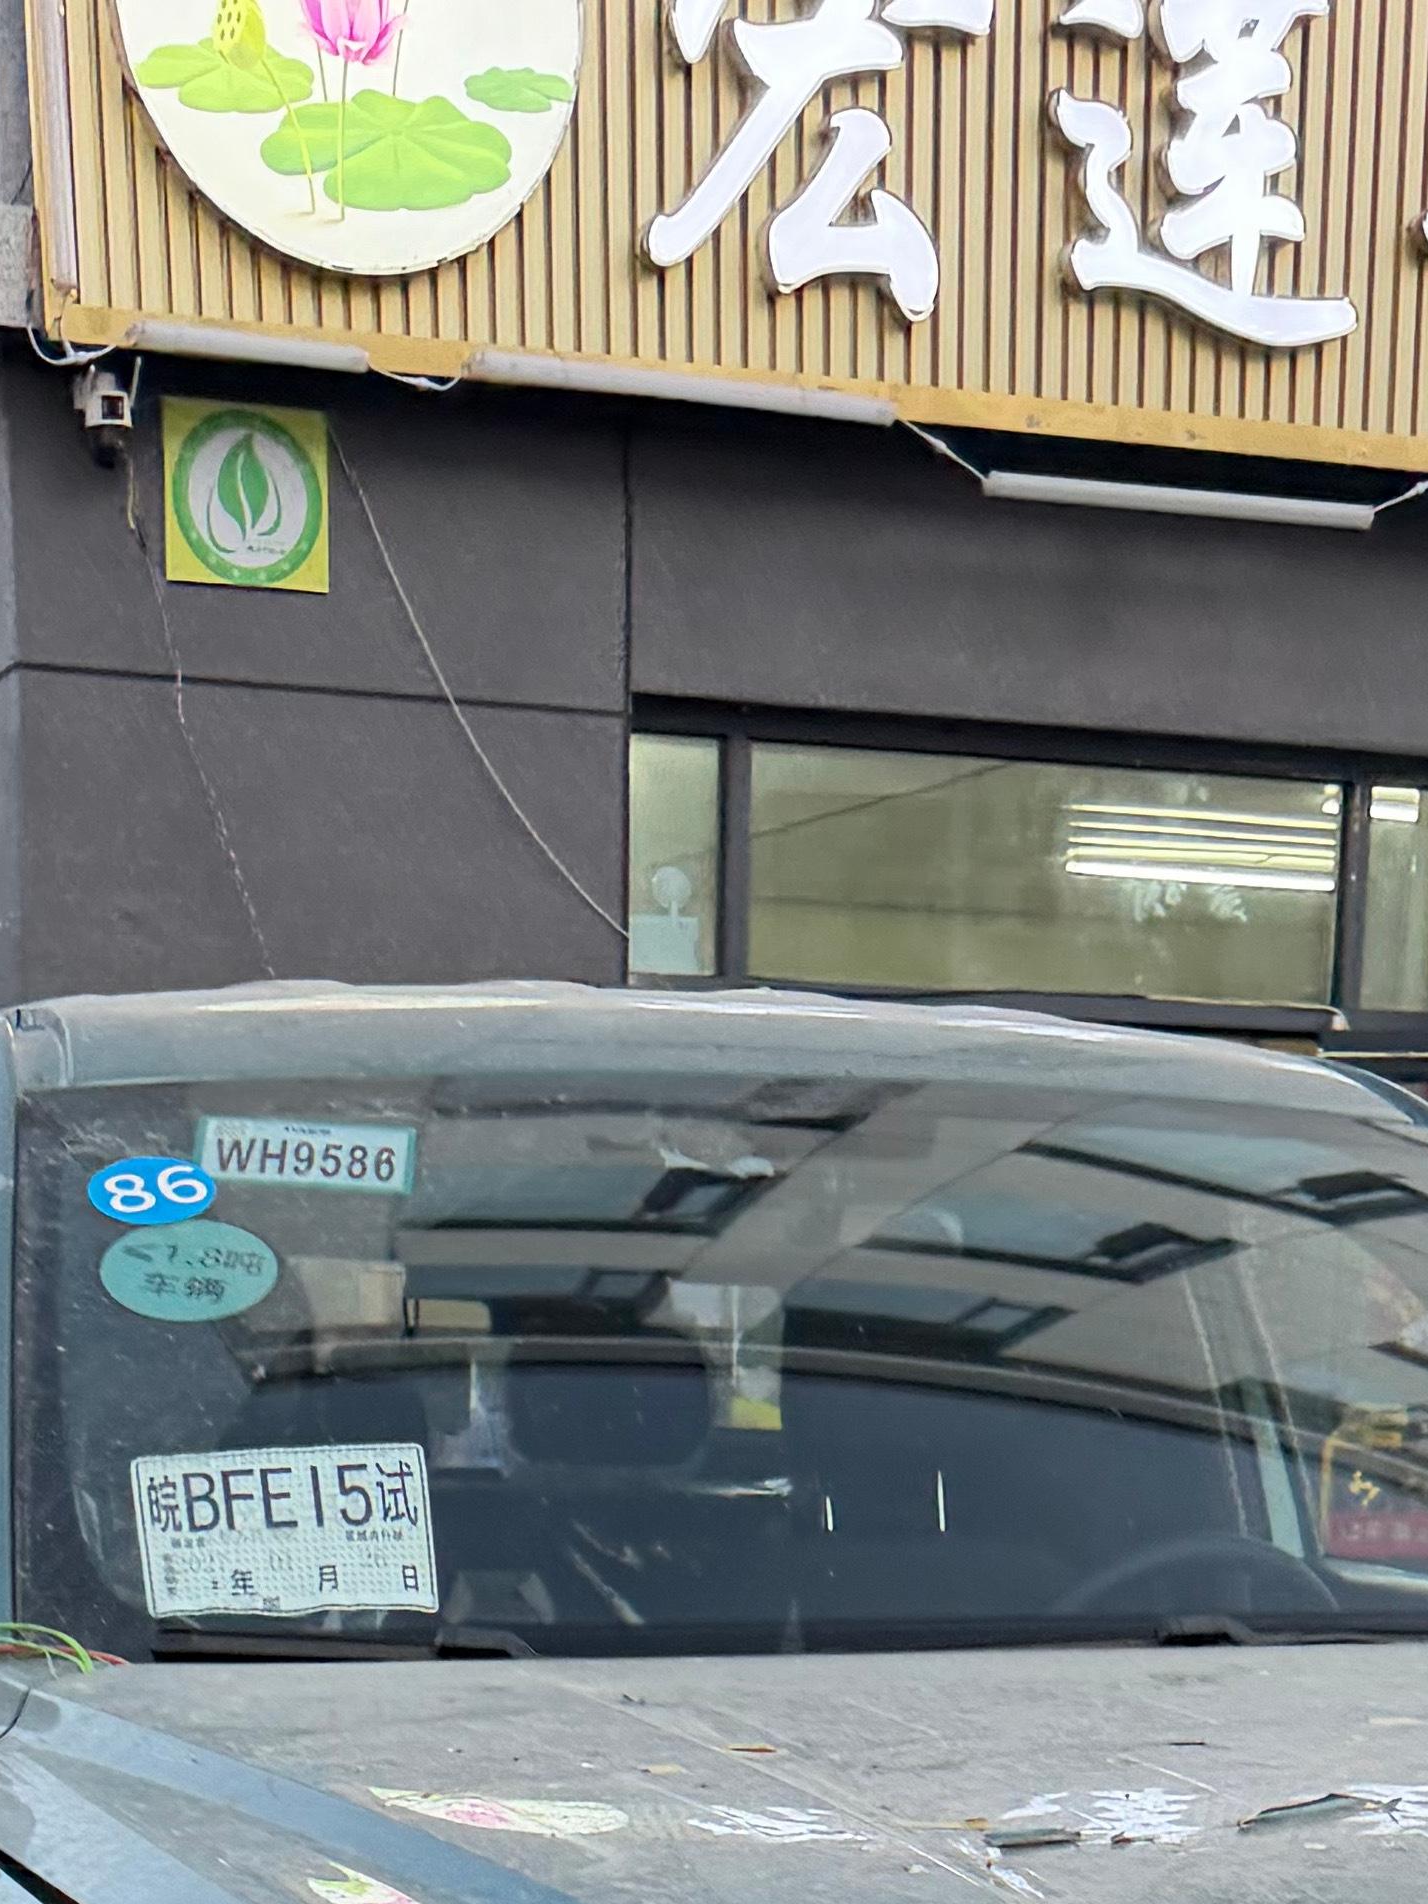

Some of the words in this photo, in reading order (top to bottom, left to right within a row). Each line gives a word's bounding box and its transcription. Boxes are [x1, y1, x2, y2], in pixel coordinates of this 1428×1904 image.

[104, 1165, 207, 1213] 86
[147, 1460, 418, 1533] 皖BFE15试
[319, 1564, 338, 1592] 月
[401, 1564, 419, 1592] 日
